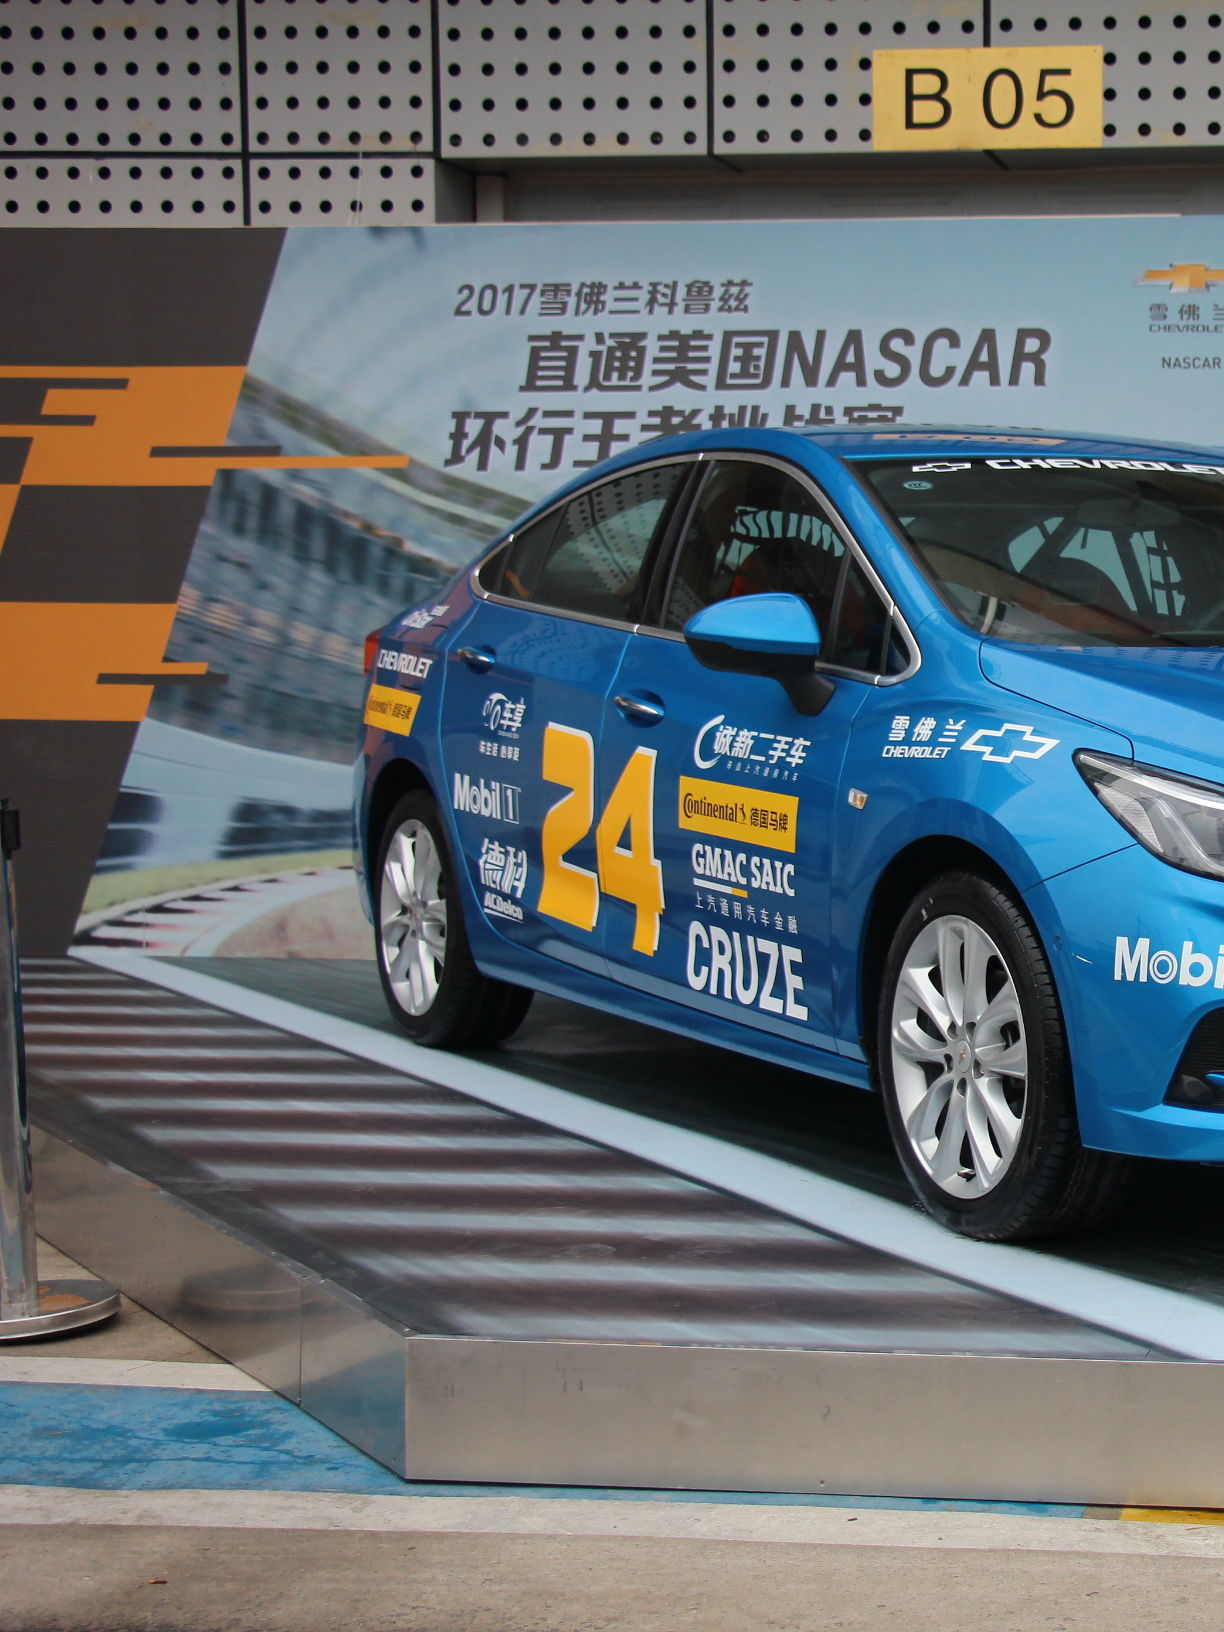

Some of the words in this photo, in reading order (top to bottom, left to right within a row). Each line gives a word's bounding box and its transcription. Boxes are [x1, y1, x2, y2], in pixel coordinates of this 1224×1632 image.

[905, 68, 952, 130] B
[982, 68, 1075, 130] 05
[518, 327, 1052, 393] 直通美国NASCAR
[1161, 357, 1222, 369] NASCAR
[377, 648, 433, 679] CHEVROLET
[713, 725, 811, 768] 诚新二手车
[888, 715, 967, 742] 雪佛兰
[882, 745, 952, 759] CHEVROLET
[454, 772, 502, 820] Mobil
[683, 793, 738, 823] Continental
[538, 721, 665, 957] 24
[692, 843, 748, 885] GMAC
[750, 856, 796, 897] SAIC
[484, 891, 524, 920] ACDelco
[687, 920, 809, 1021] CRUZE
